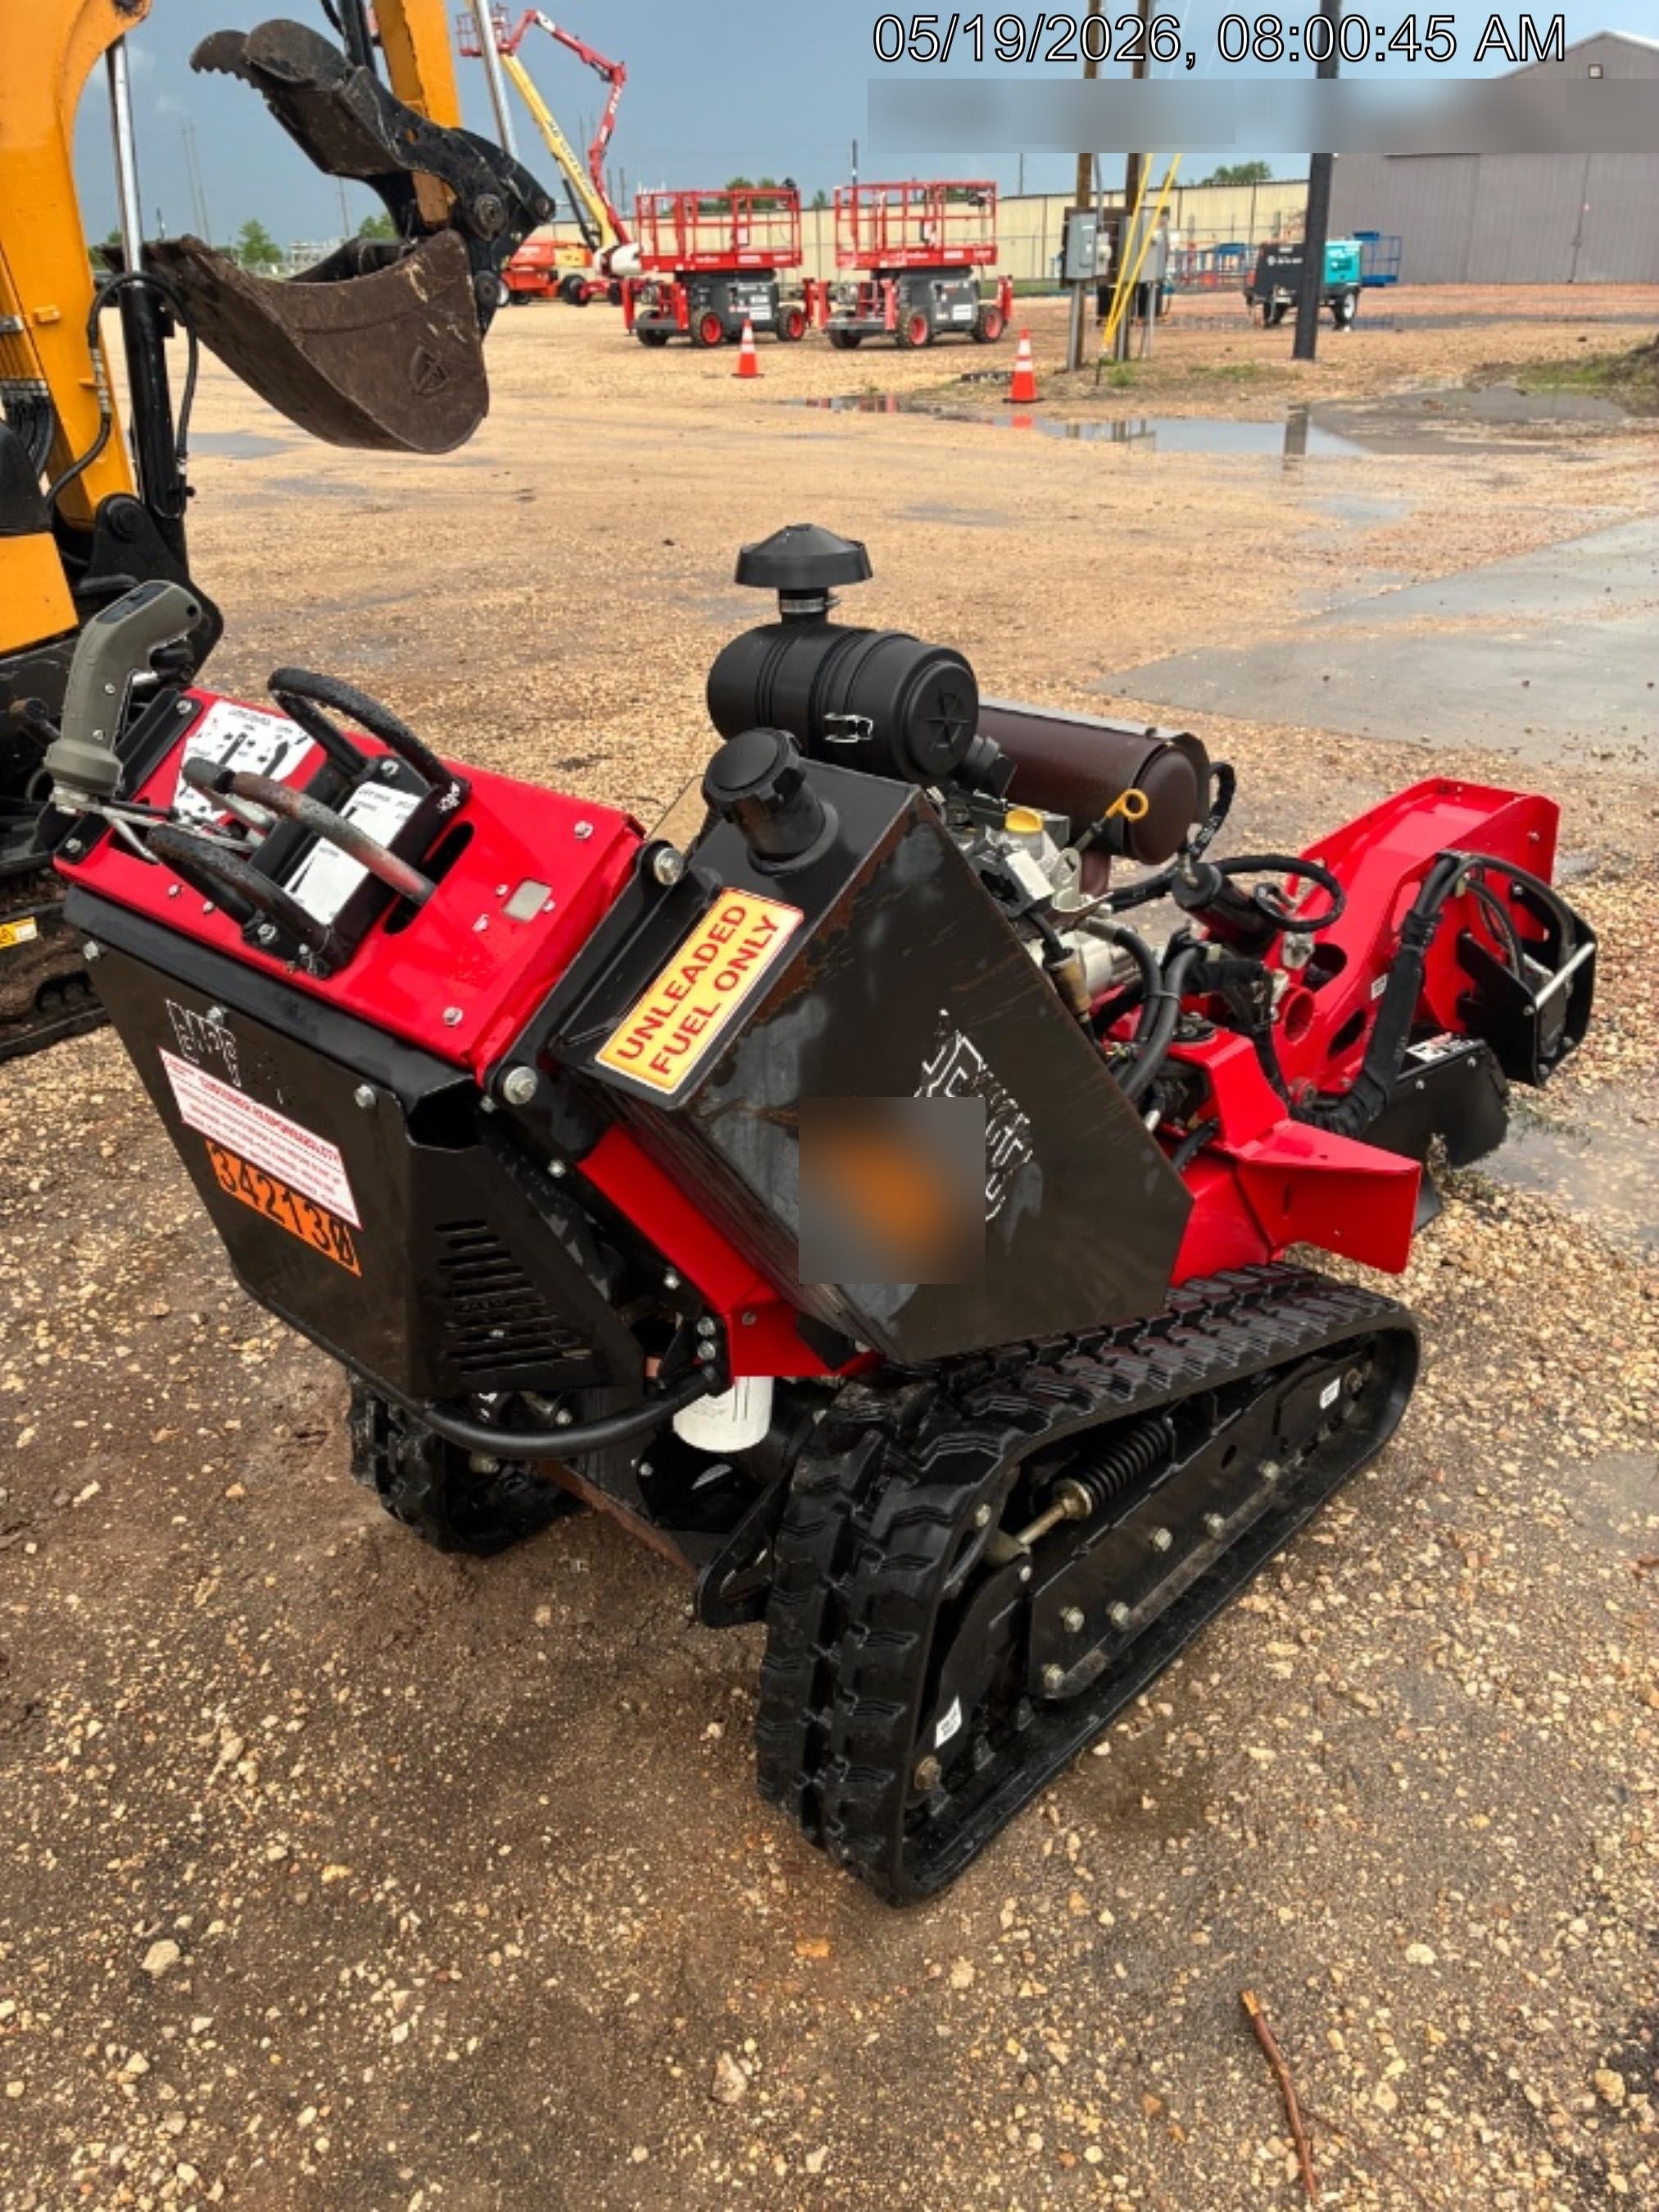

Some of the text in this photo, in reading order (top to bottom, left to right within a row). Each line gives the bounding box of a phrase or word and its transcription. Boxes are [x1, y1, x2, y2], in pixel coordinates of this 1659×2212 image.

[616, 906, 746, 1059] UNLEADED
[649, 914, 780, 1076] FUEL ONLY
